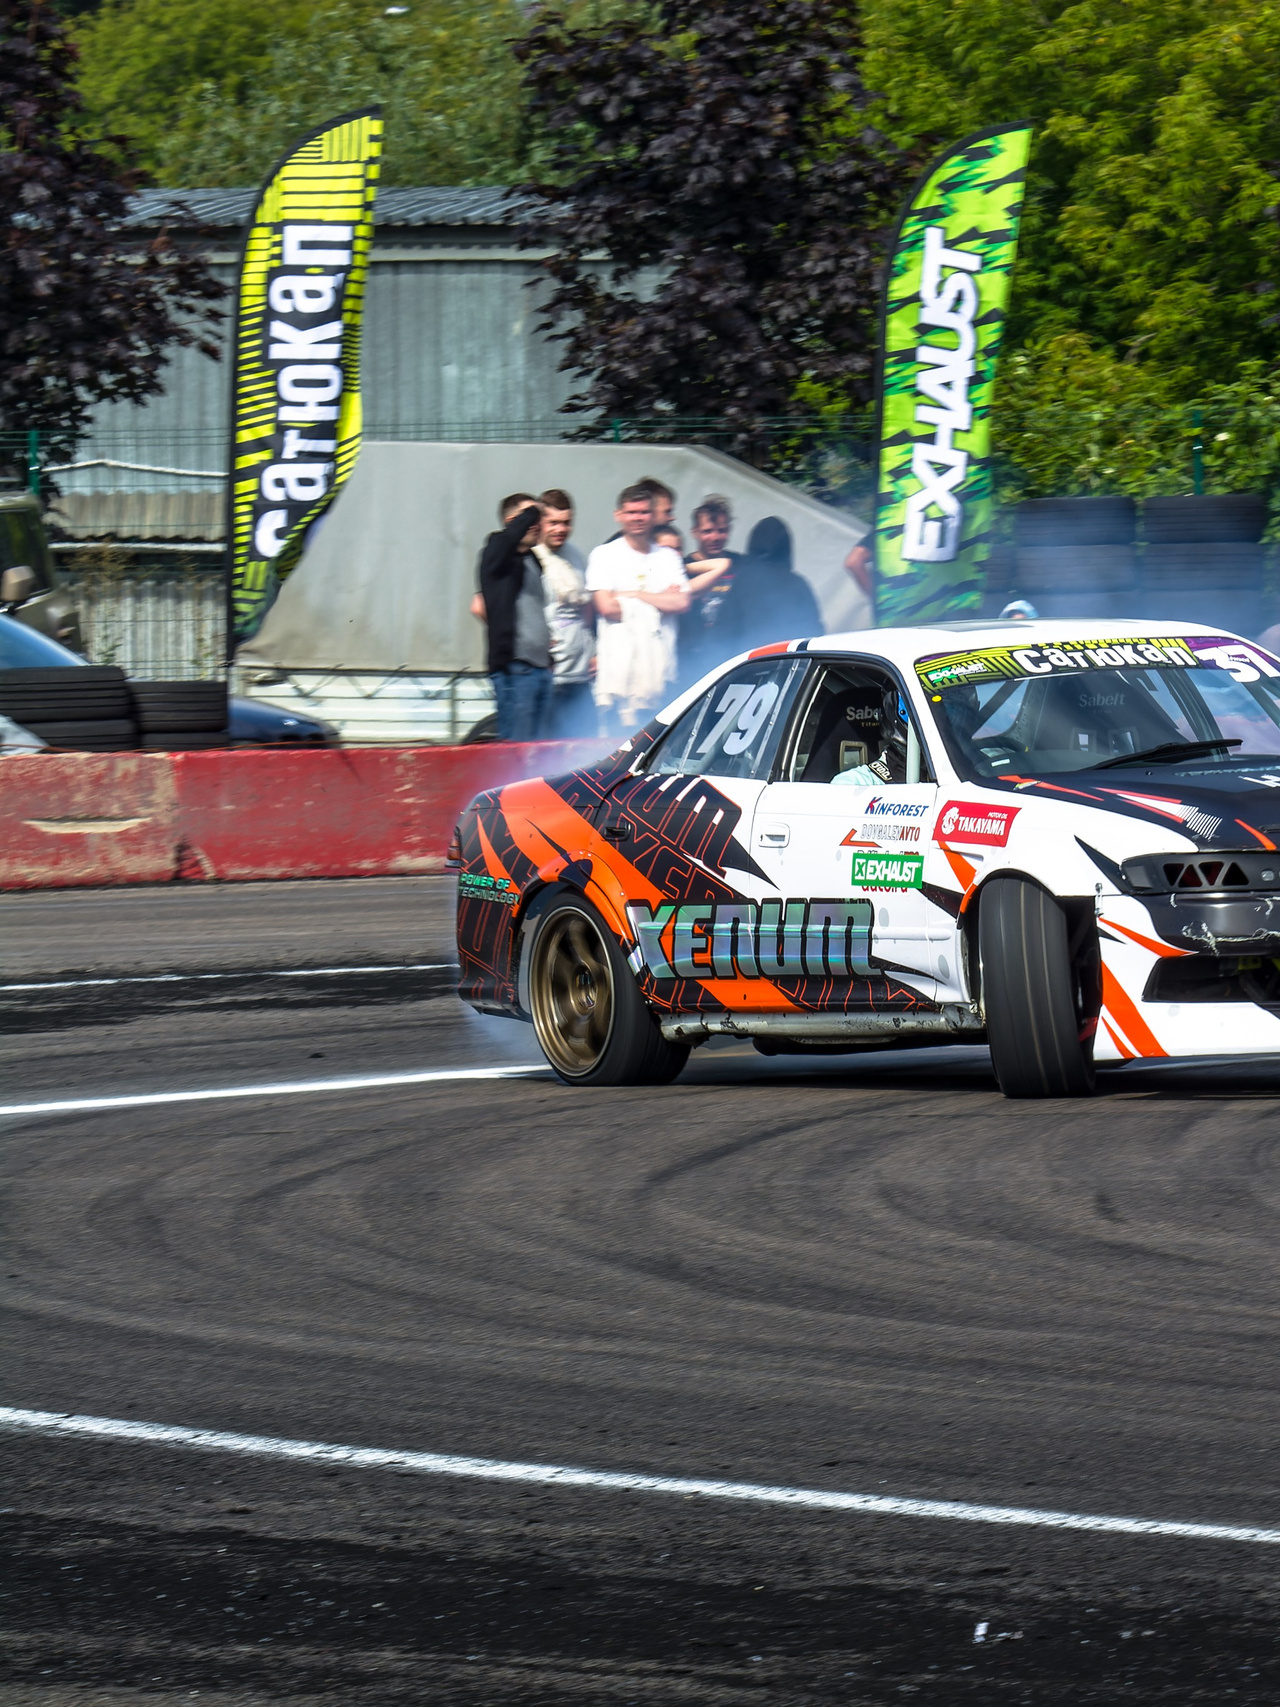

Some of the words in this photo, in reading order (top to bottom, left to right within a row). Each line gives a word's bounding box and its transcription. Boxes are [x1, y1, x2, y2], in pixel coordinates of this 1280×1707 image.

[902, 226, 982, 562] EXHAUST
[1079, 693, 1126, 707] Sabelt
[695, 682, 779, 755] 79
[865, 797, 929, 817] KINFOREST
[958, 816, 1006, 835] TAKAYAMA
[866, 860, 921, 882] EXHAUST
[460, 873, 494, 888] POWER
[496, 878, 510, 890] OF
